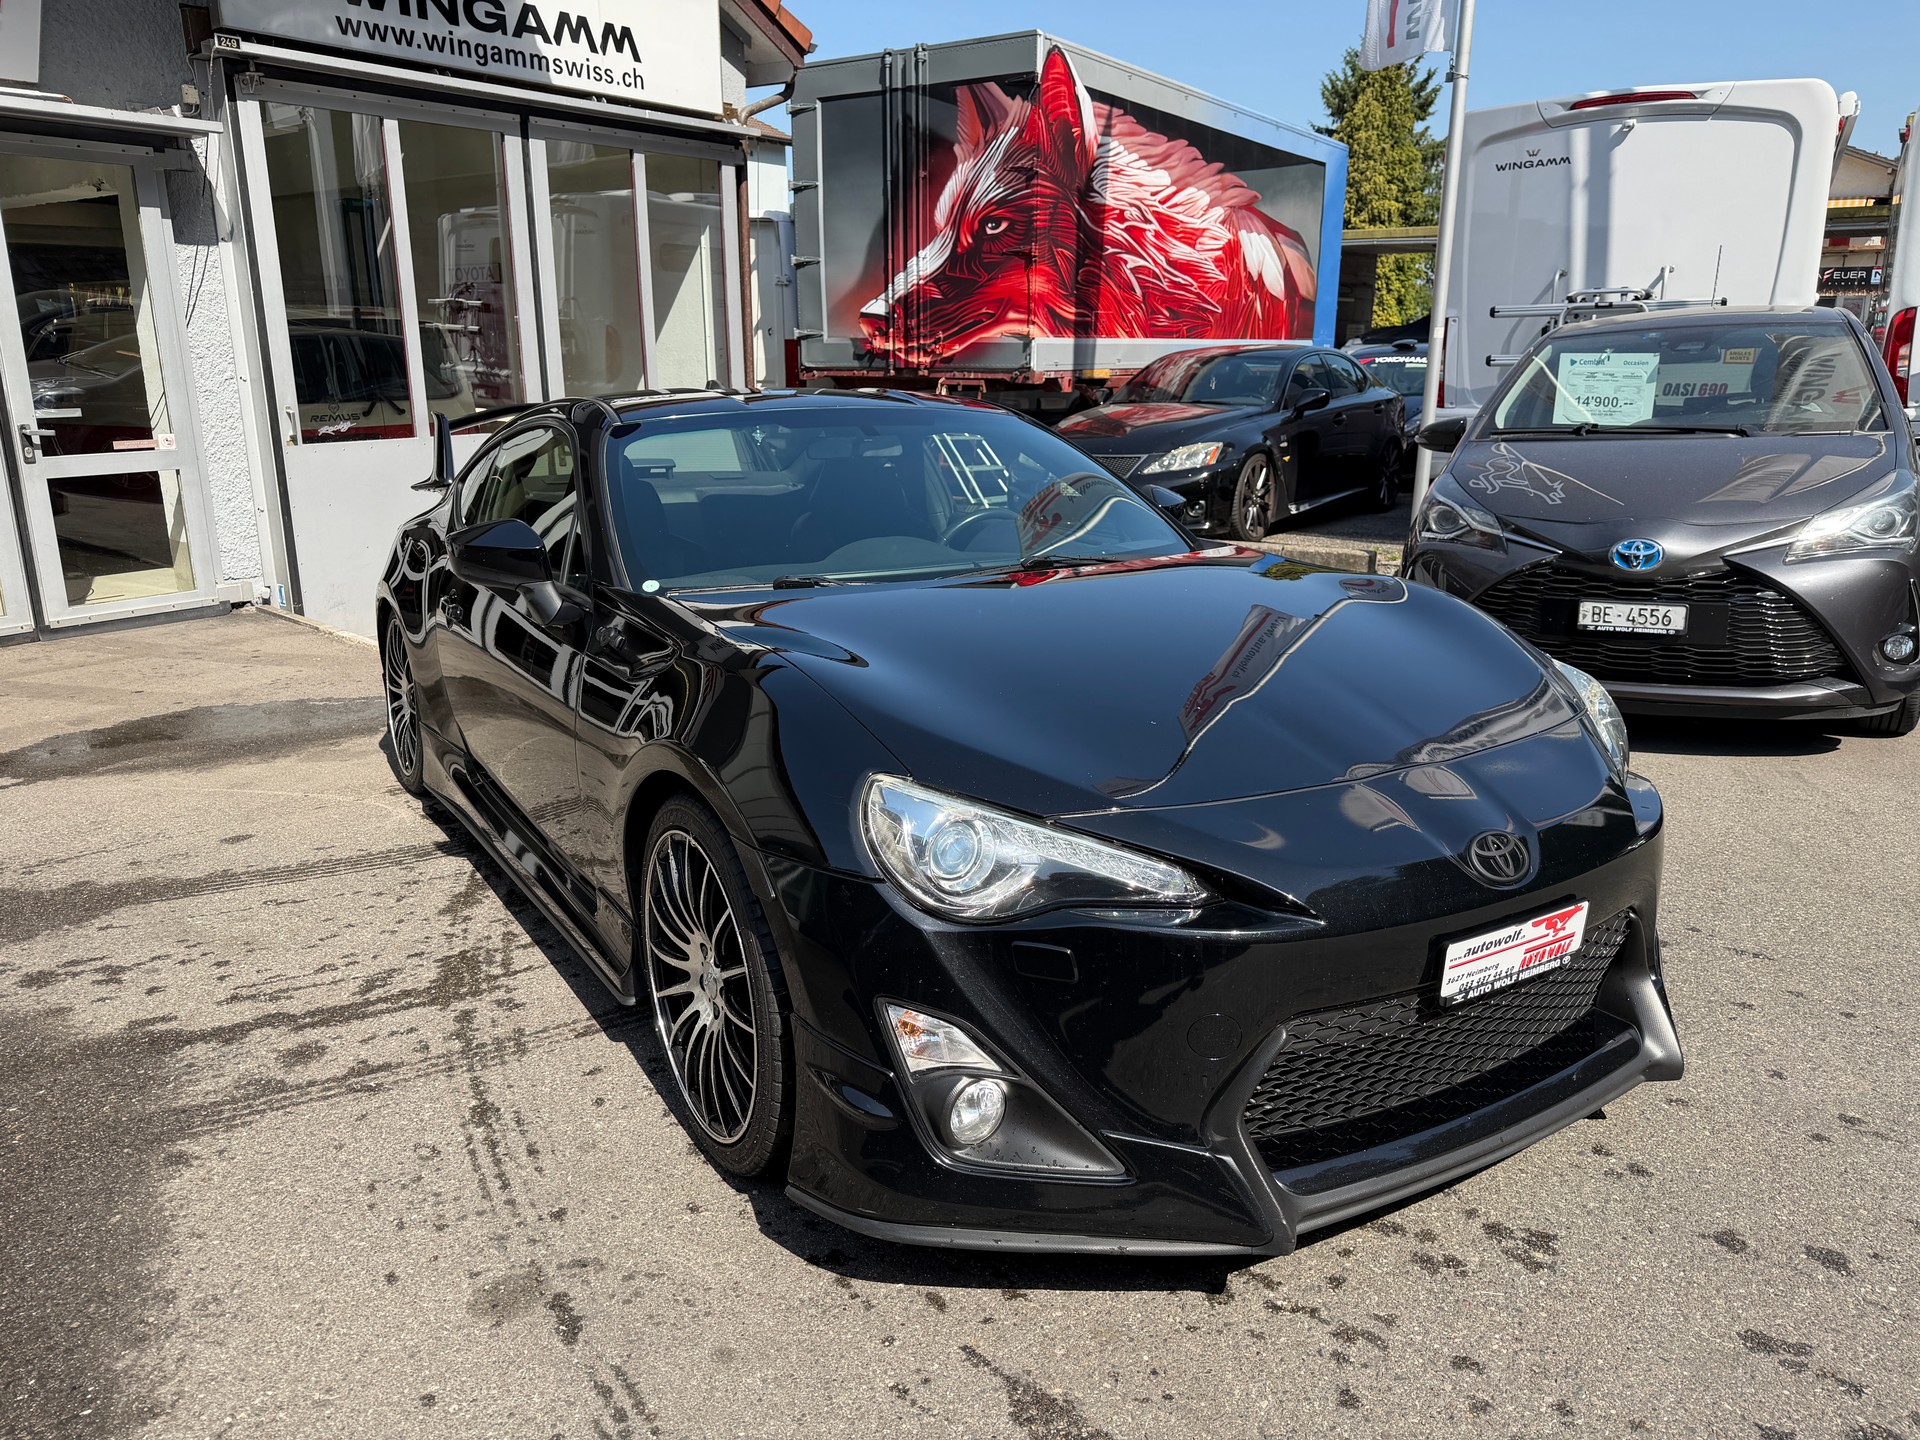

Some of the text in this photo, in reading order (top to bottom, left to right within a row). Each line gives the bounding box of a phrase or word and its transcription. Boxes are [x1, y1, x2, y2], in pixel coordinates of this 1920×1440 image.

[345, 0, 642, 63] NGAMM
[220, 37, 238, 48] 249
[335, 15, 645, 90] www.wingammswiss.ch
[1495, 156, 1571, 172] WINGAMM
[1662, 382, 1729, 397] OASI 690
[310, 413, 360, 423] REMUS
[1591, 606, 1672, 627] BE 4556
[1633, 627, 1667, 635] HEIMBERG
[1446, 962, 1500, 986] 3627 Heimberg
[1467, 959, 1561, 999] AUTO WOLF HEIMBERG
